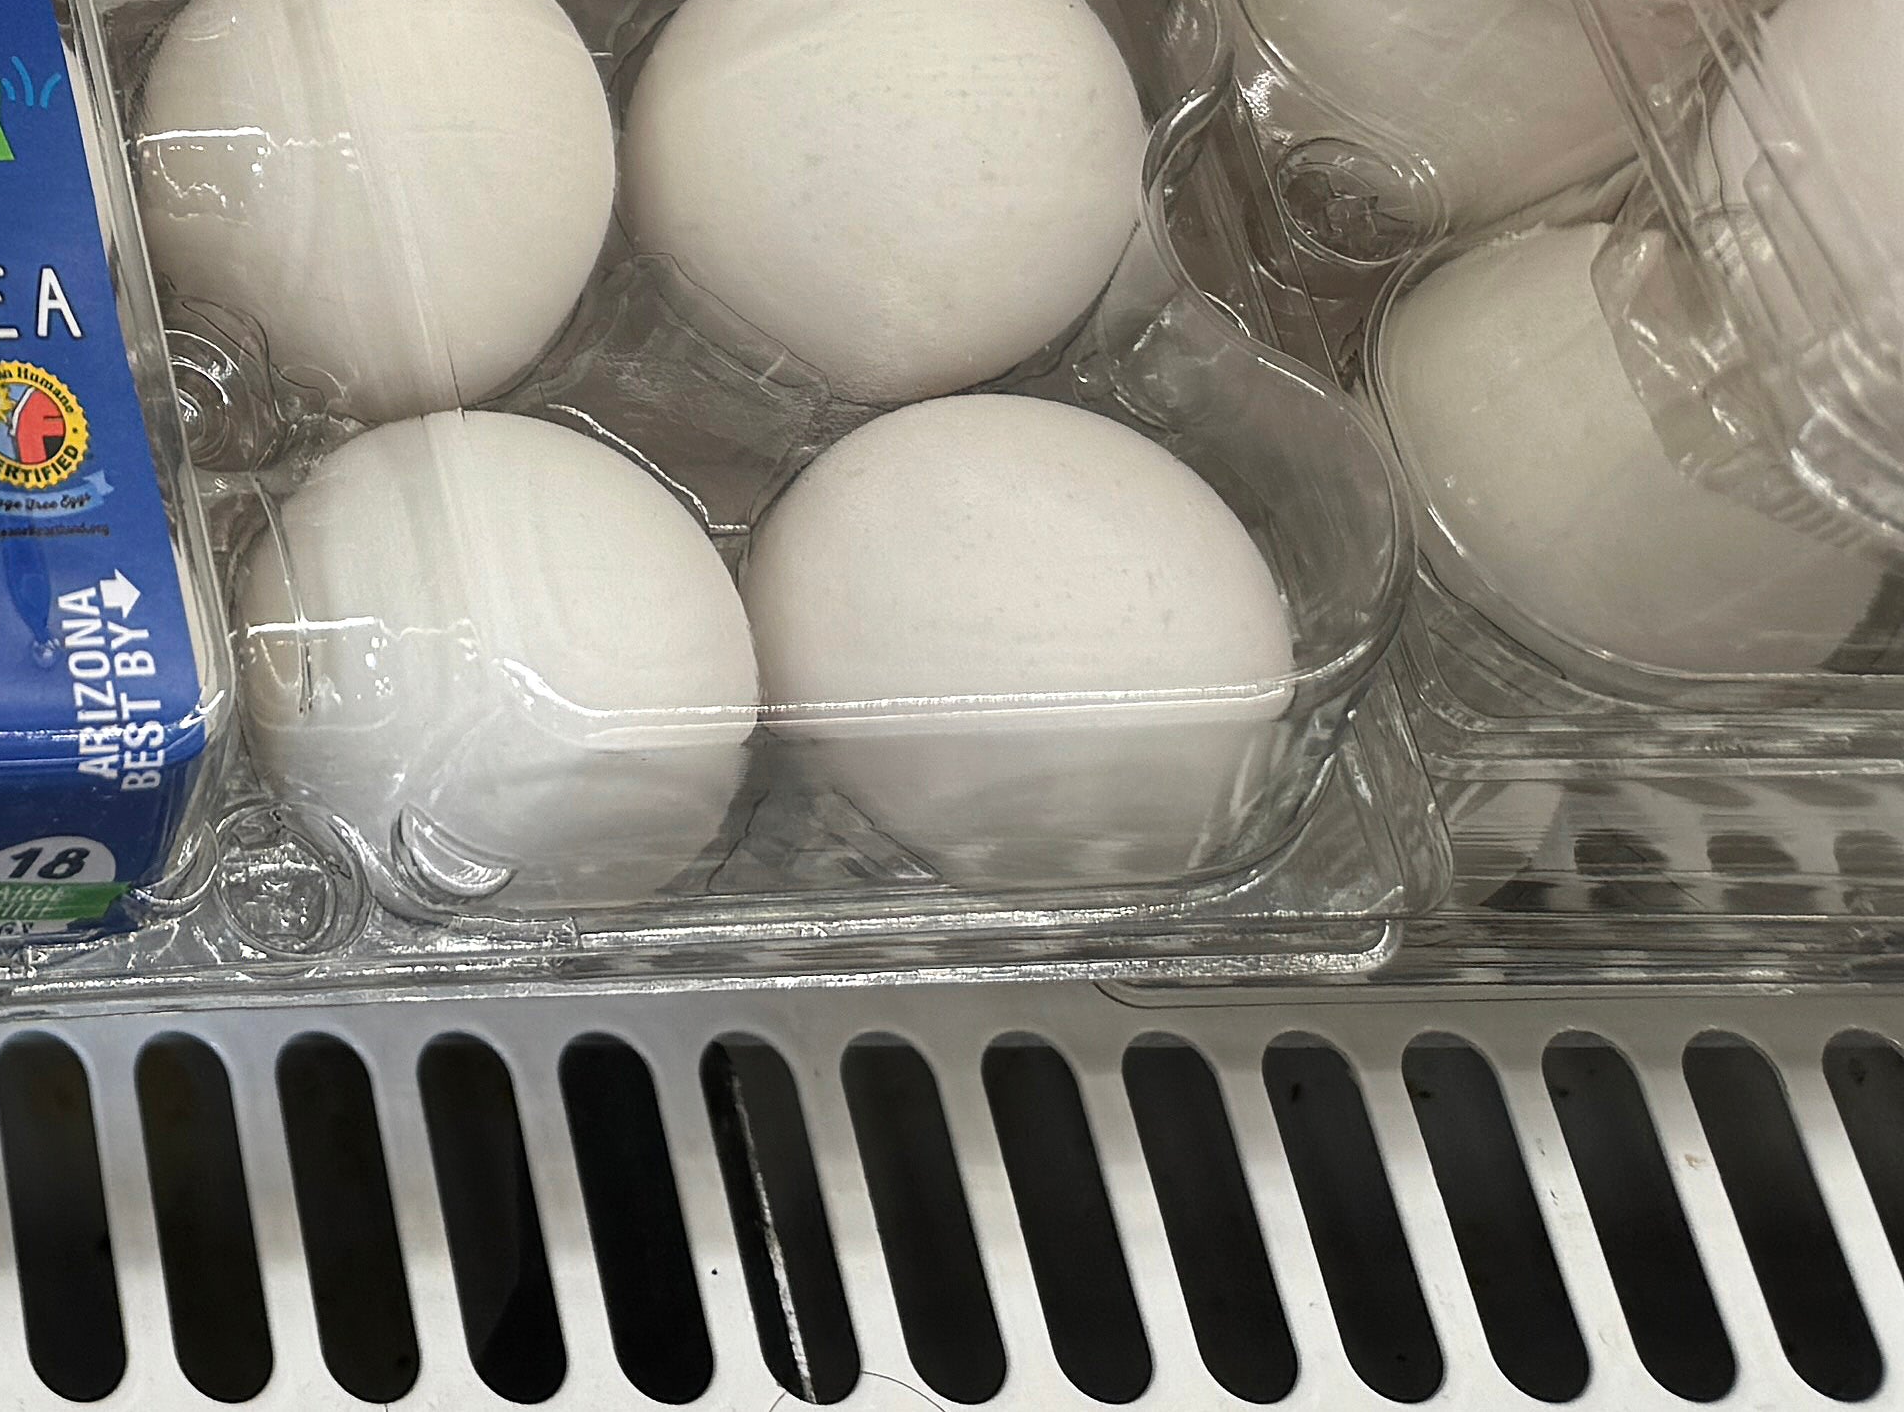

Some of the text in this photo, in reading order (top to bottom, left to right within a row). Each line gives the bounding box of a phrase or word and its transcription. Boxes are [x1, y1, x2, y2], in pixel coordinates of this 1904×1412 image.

[38, 267, 84, 340] A
[16, 367, 75, 414] Humane
[58, 587, 120, 779] ARIZONA
[107, 621, 165, 791] BEST BY
